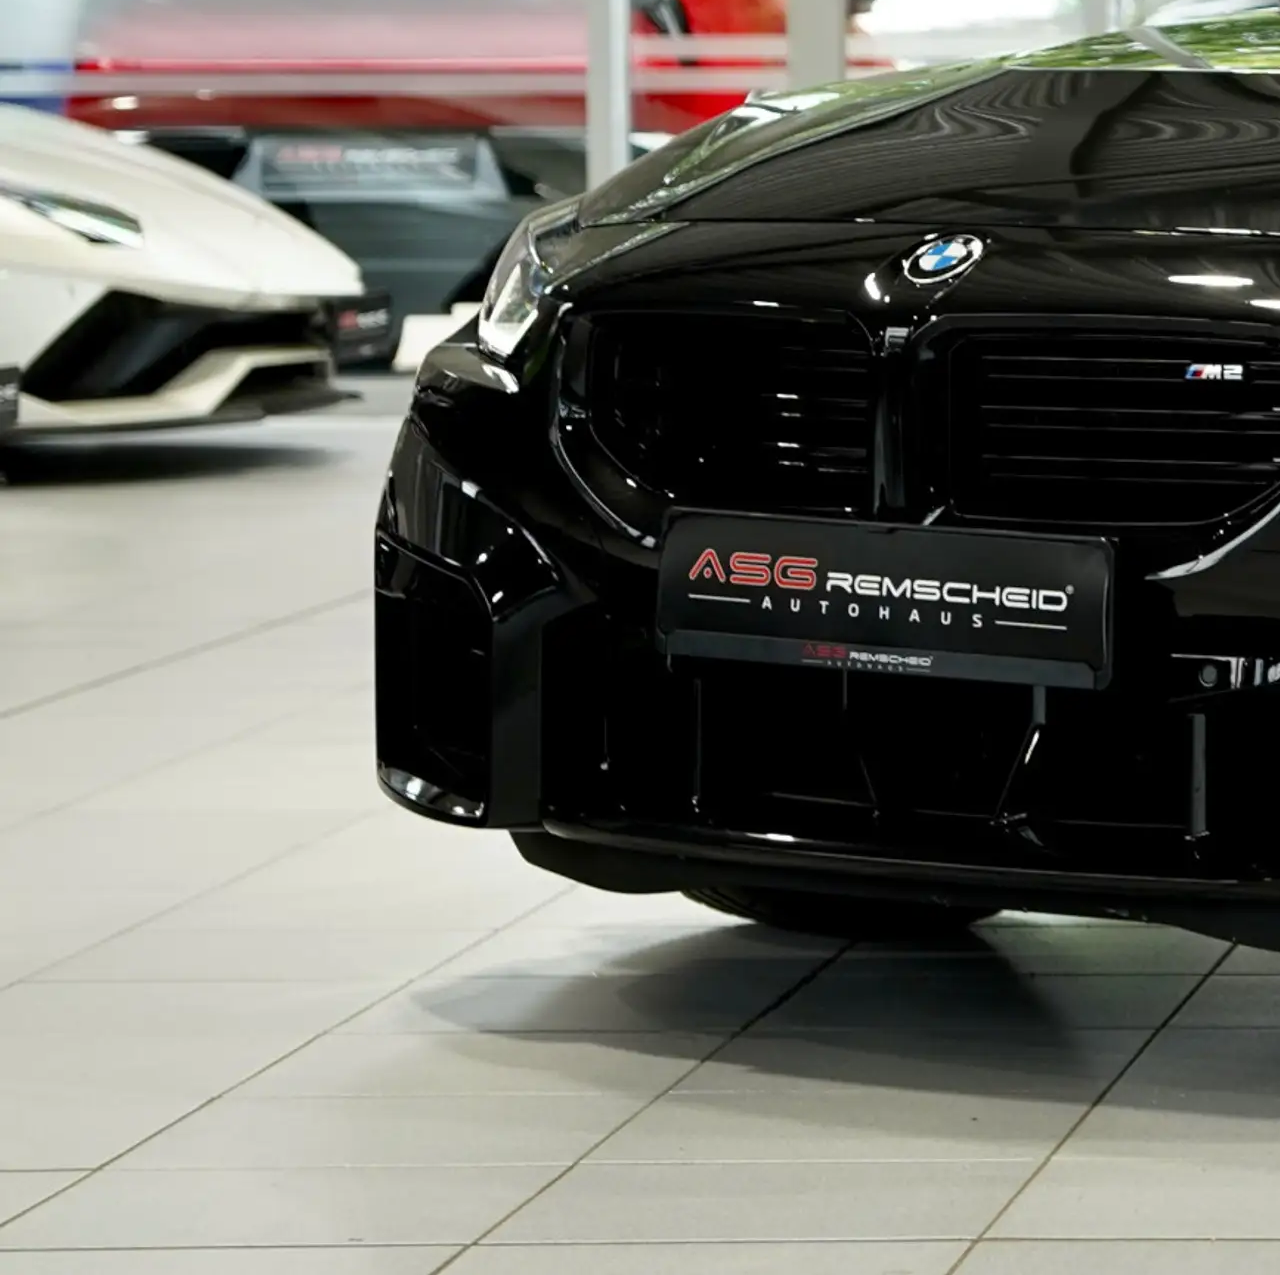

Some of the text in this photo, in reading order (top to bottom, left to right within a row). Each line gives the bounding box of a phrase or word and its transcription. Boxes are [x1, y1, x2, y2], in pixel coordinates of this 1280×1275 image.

[1187, 364, 1244, 381] M2
[689, 548, 1069, 612] ASG REMSCHEID
[761, 596, 984, 628] AUTOHAUS
